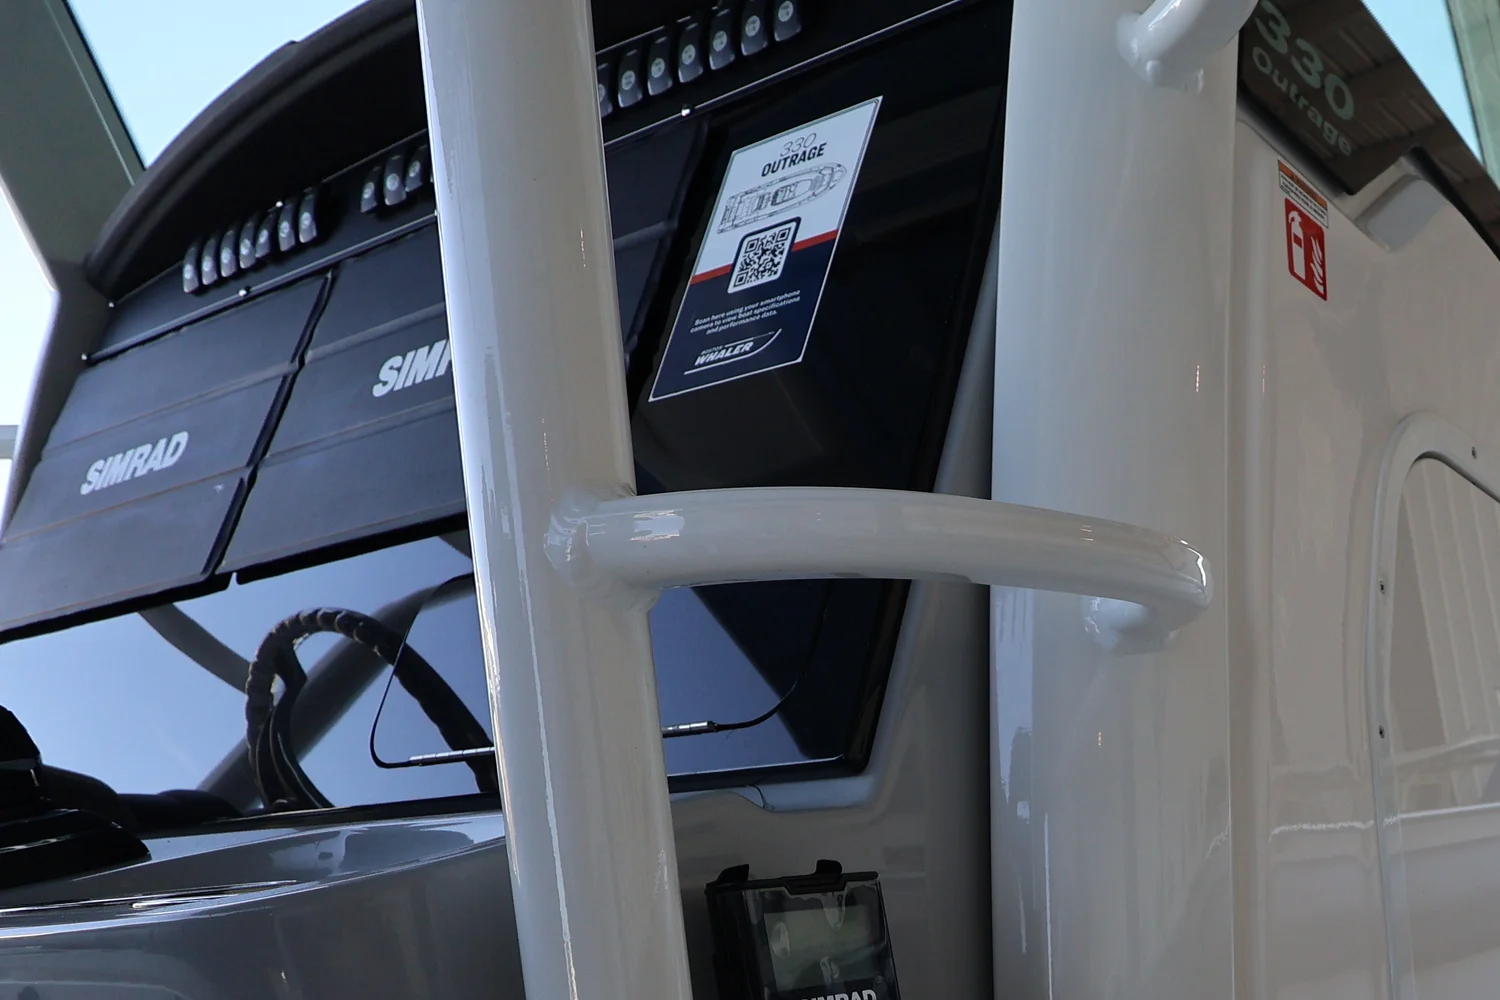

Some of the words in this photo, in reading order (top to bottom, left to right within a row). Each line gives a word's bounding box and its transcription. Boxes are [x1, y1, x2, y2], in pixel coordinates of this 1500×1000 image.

[1254, 0, 1354, 121] 330
[1252, 46, 1352, 156] Outrage
[760, 142, 828, 178] OUTRAGE
[779, 132, 817, 158] 330
[753, 295, 801, 316] specifications
[759, 288, 801, 307] smartphone
[693, 341, 754, 367] WHALER
[80, 431, 189, 496] SIMRAD
